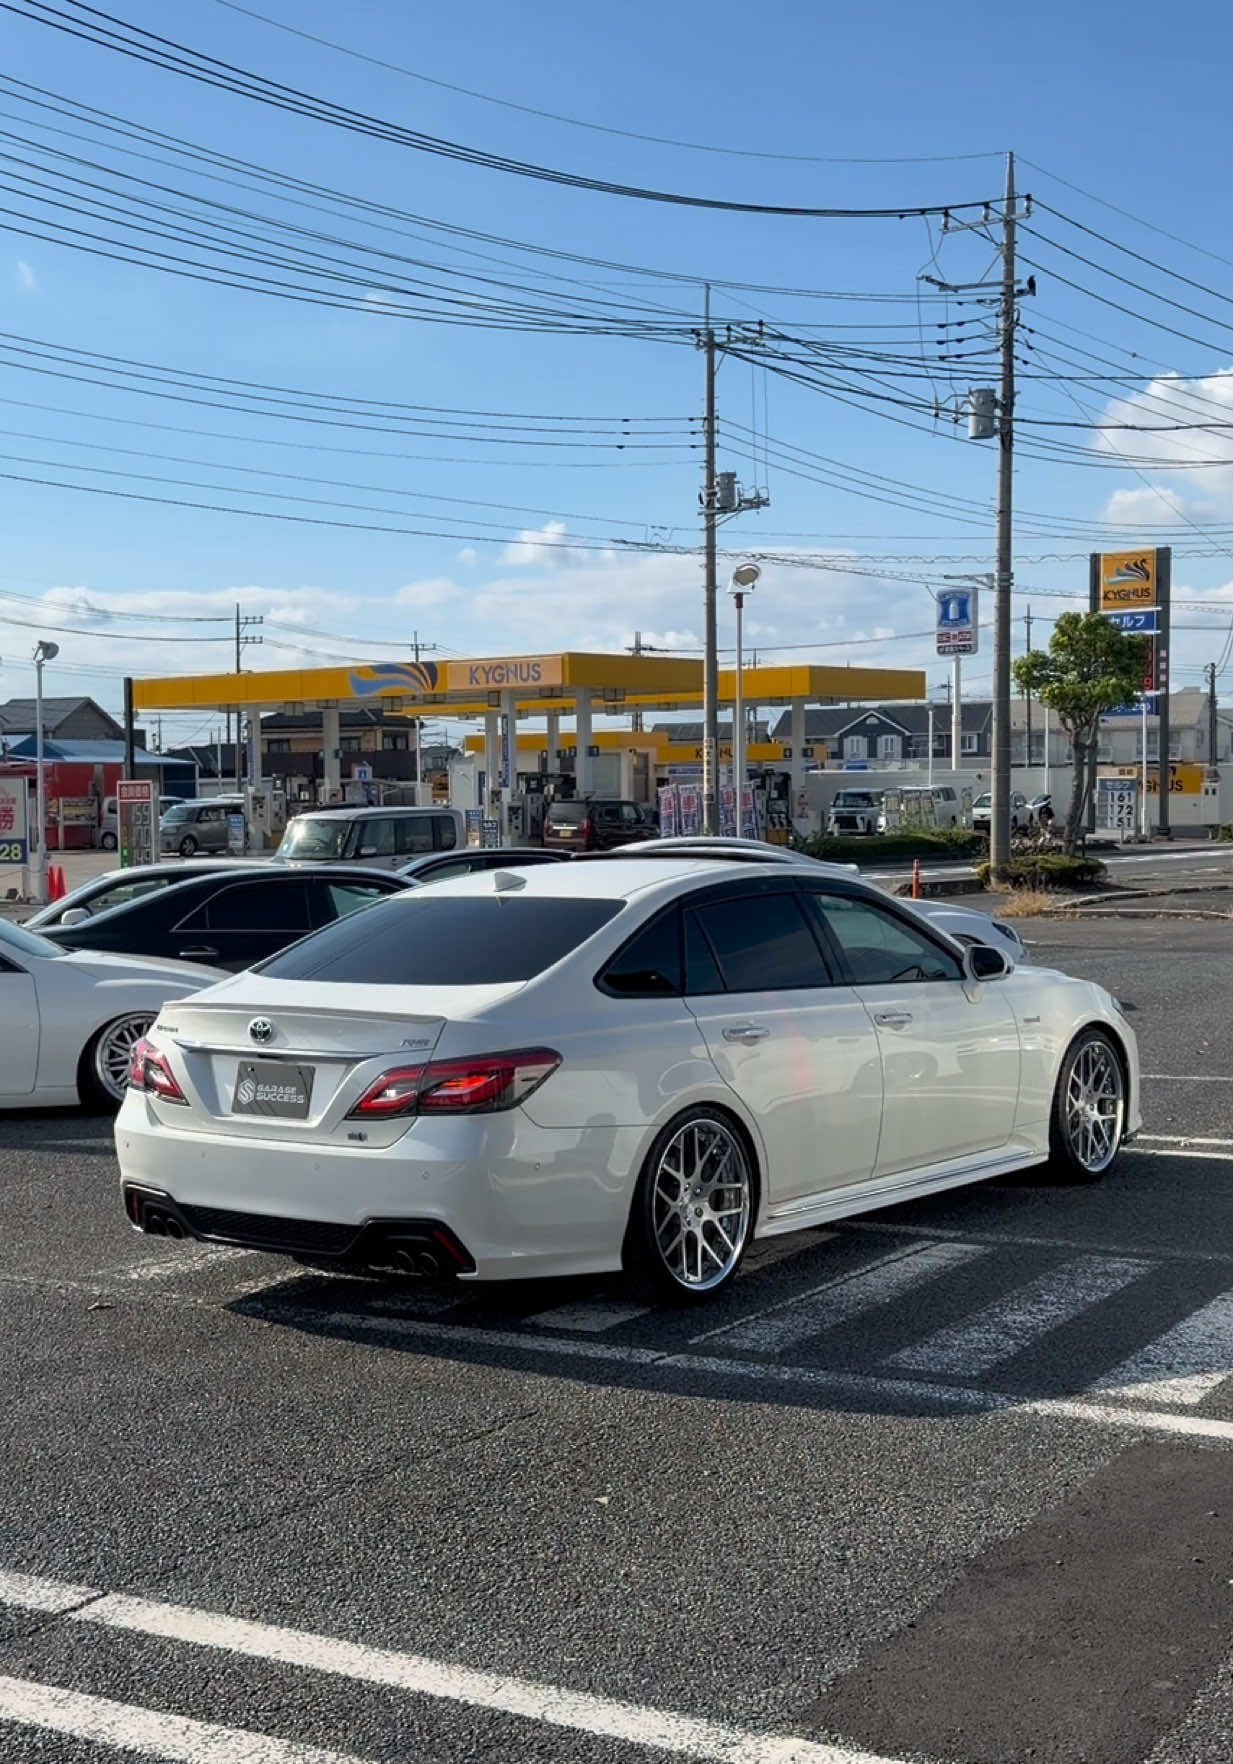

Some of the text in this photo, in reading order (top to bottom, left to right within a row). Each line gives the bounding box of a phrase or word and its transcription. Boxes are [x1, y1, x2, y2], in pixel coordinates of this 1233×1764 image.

[1103, 588, 1151, 601] KYGNUS
[469, 663, 542, 685] KYGNUS
[1110, 791, 1132, 803] 161
[1110, 803, 1134, 816] 172
[257, 1083, 297, 1094] GARAGE
[256, 1091, 304, 1104] SUCCESS
